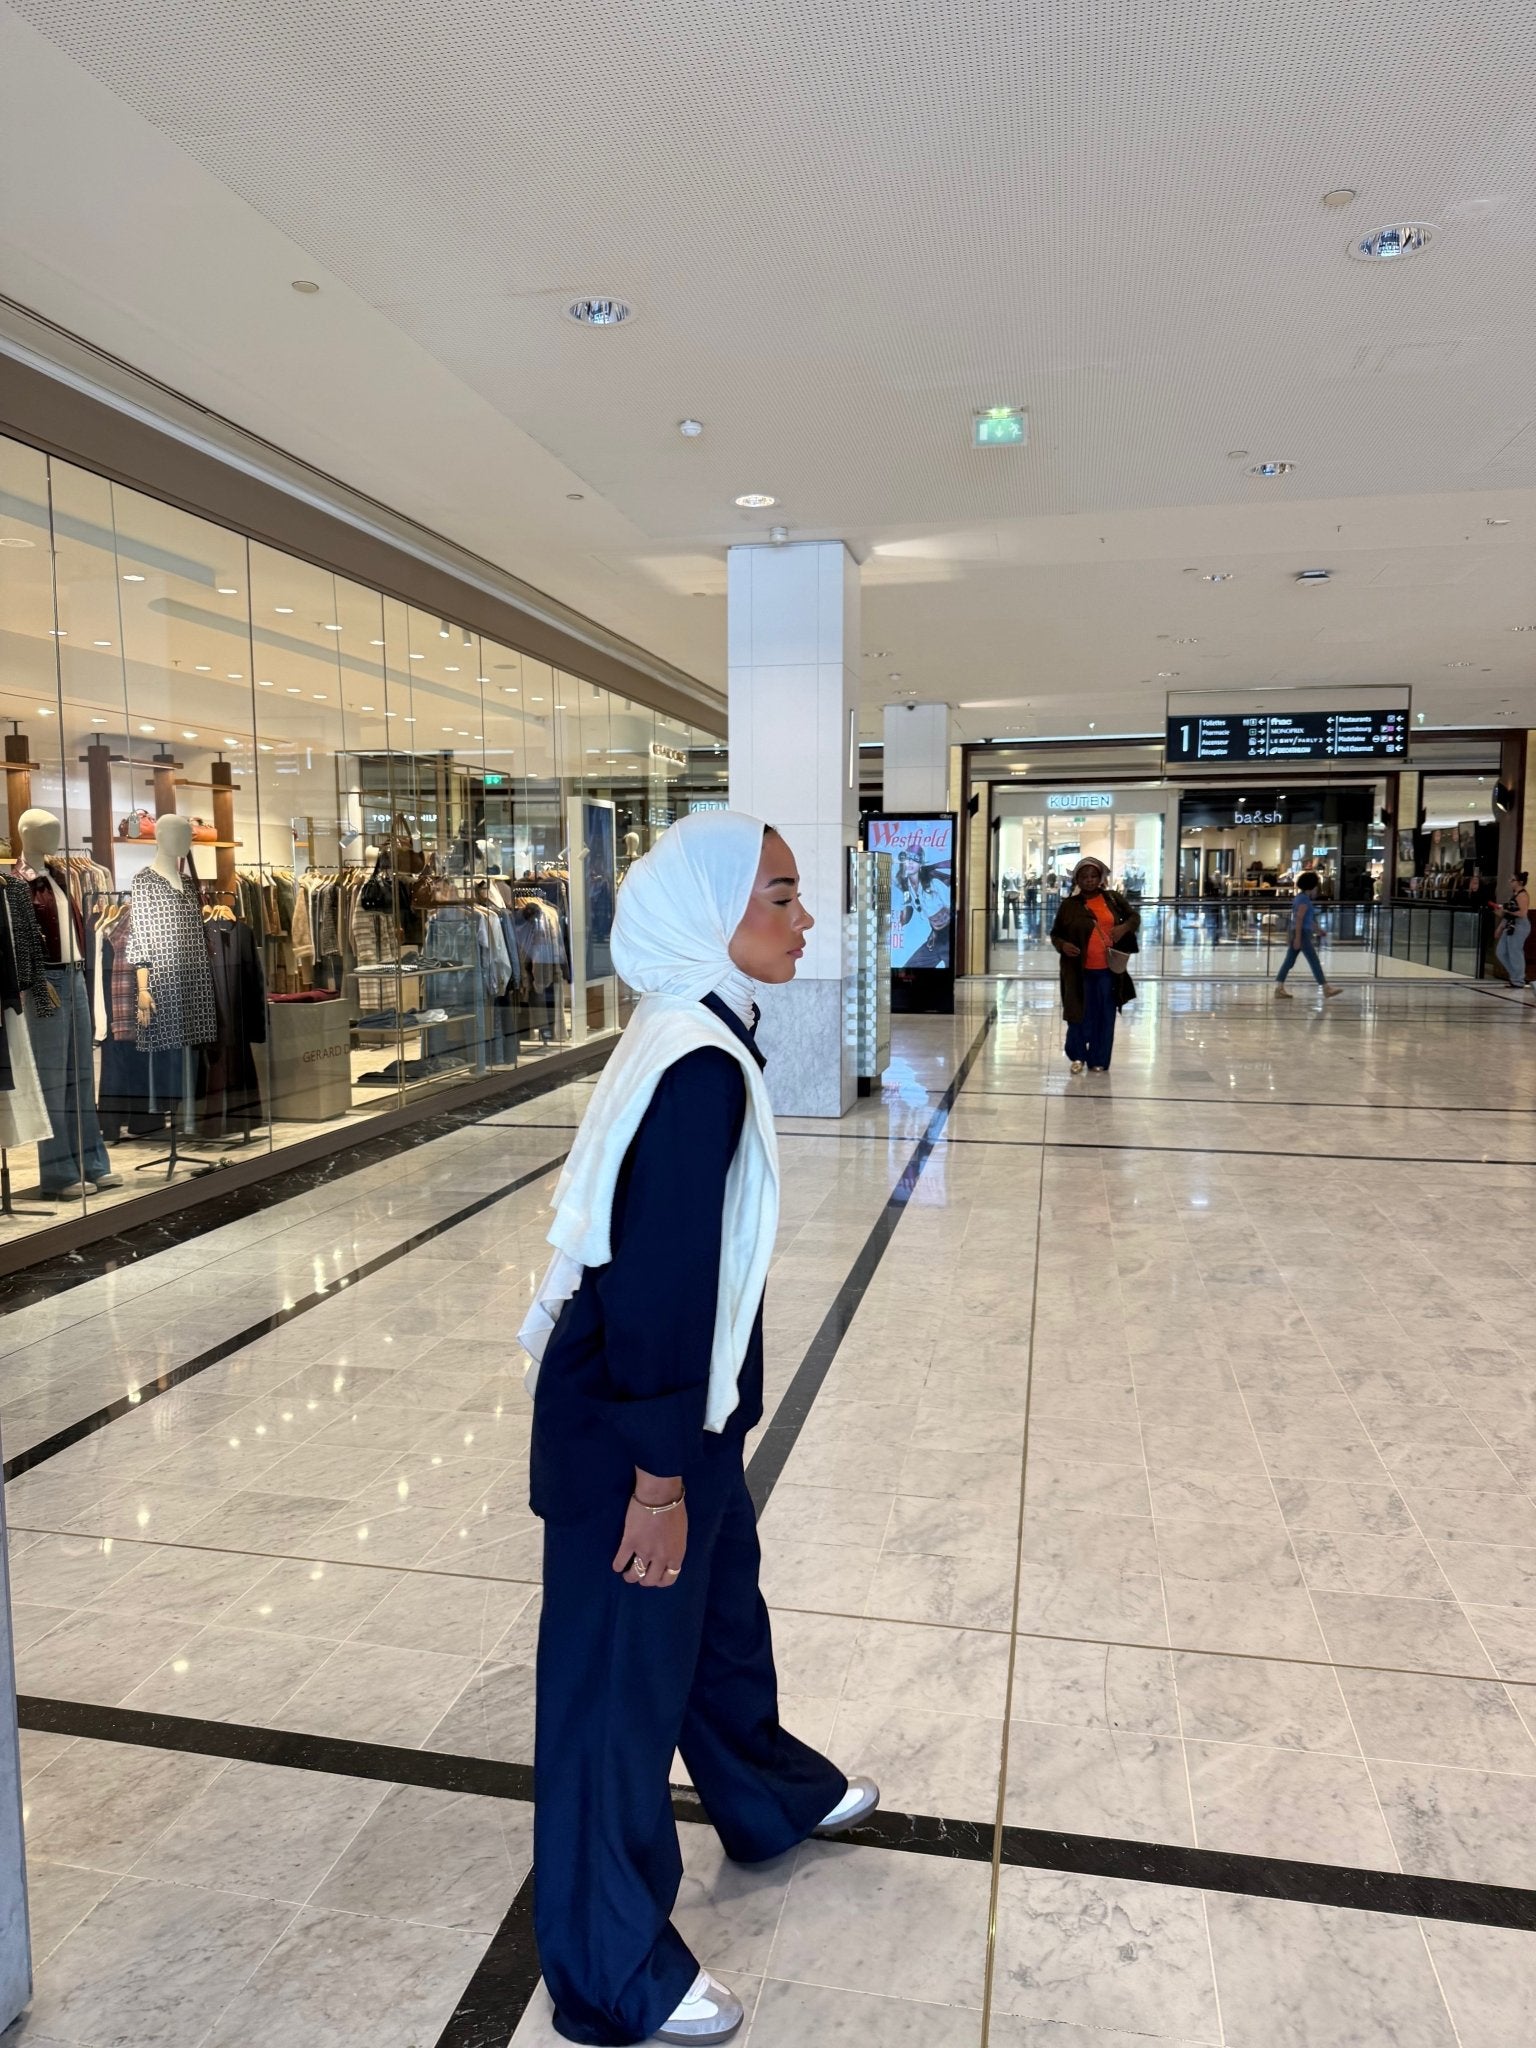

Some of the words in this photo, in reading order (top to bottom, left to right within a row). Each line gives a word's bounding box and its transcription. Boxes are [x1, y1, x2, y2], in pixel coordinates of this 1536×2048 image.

[1270, 717, 1293, 726] fnac
[1270, 727, 1305, 735] MONOPRIX
[1181, 725, 1189, 752] 1
[1048, 795, 1111, 808] KUJTEN
[1234, 810, 1282, 824] ba&sh
[871, 821, 950, 849] Westfield
[302, 1045, 342, 1063] GERARD
